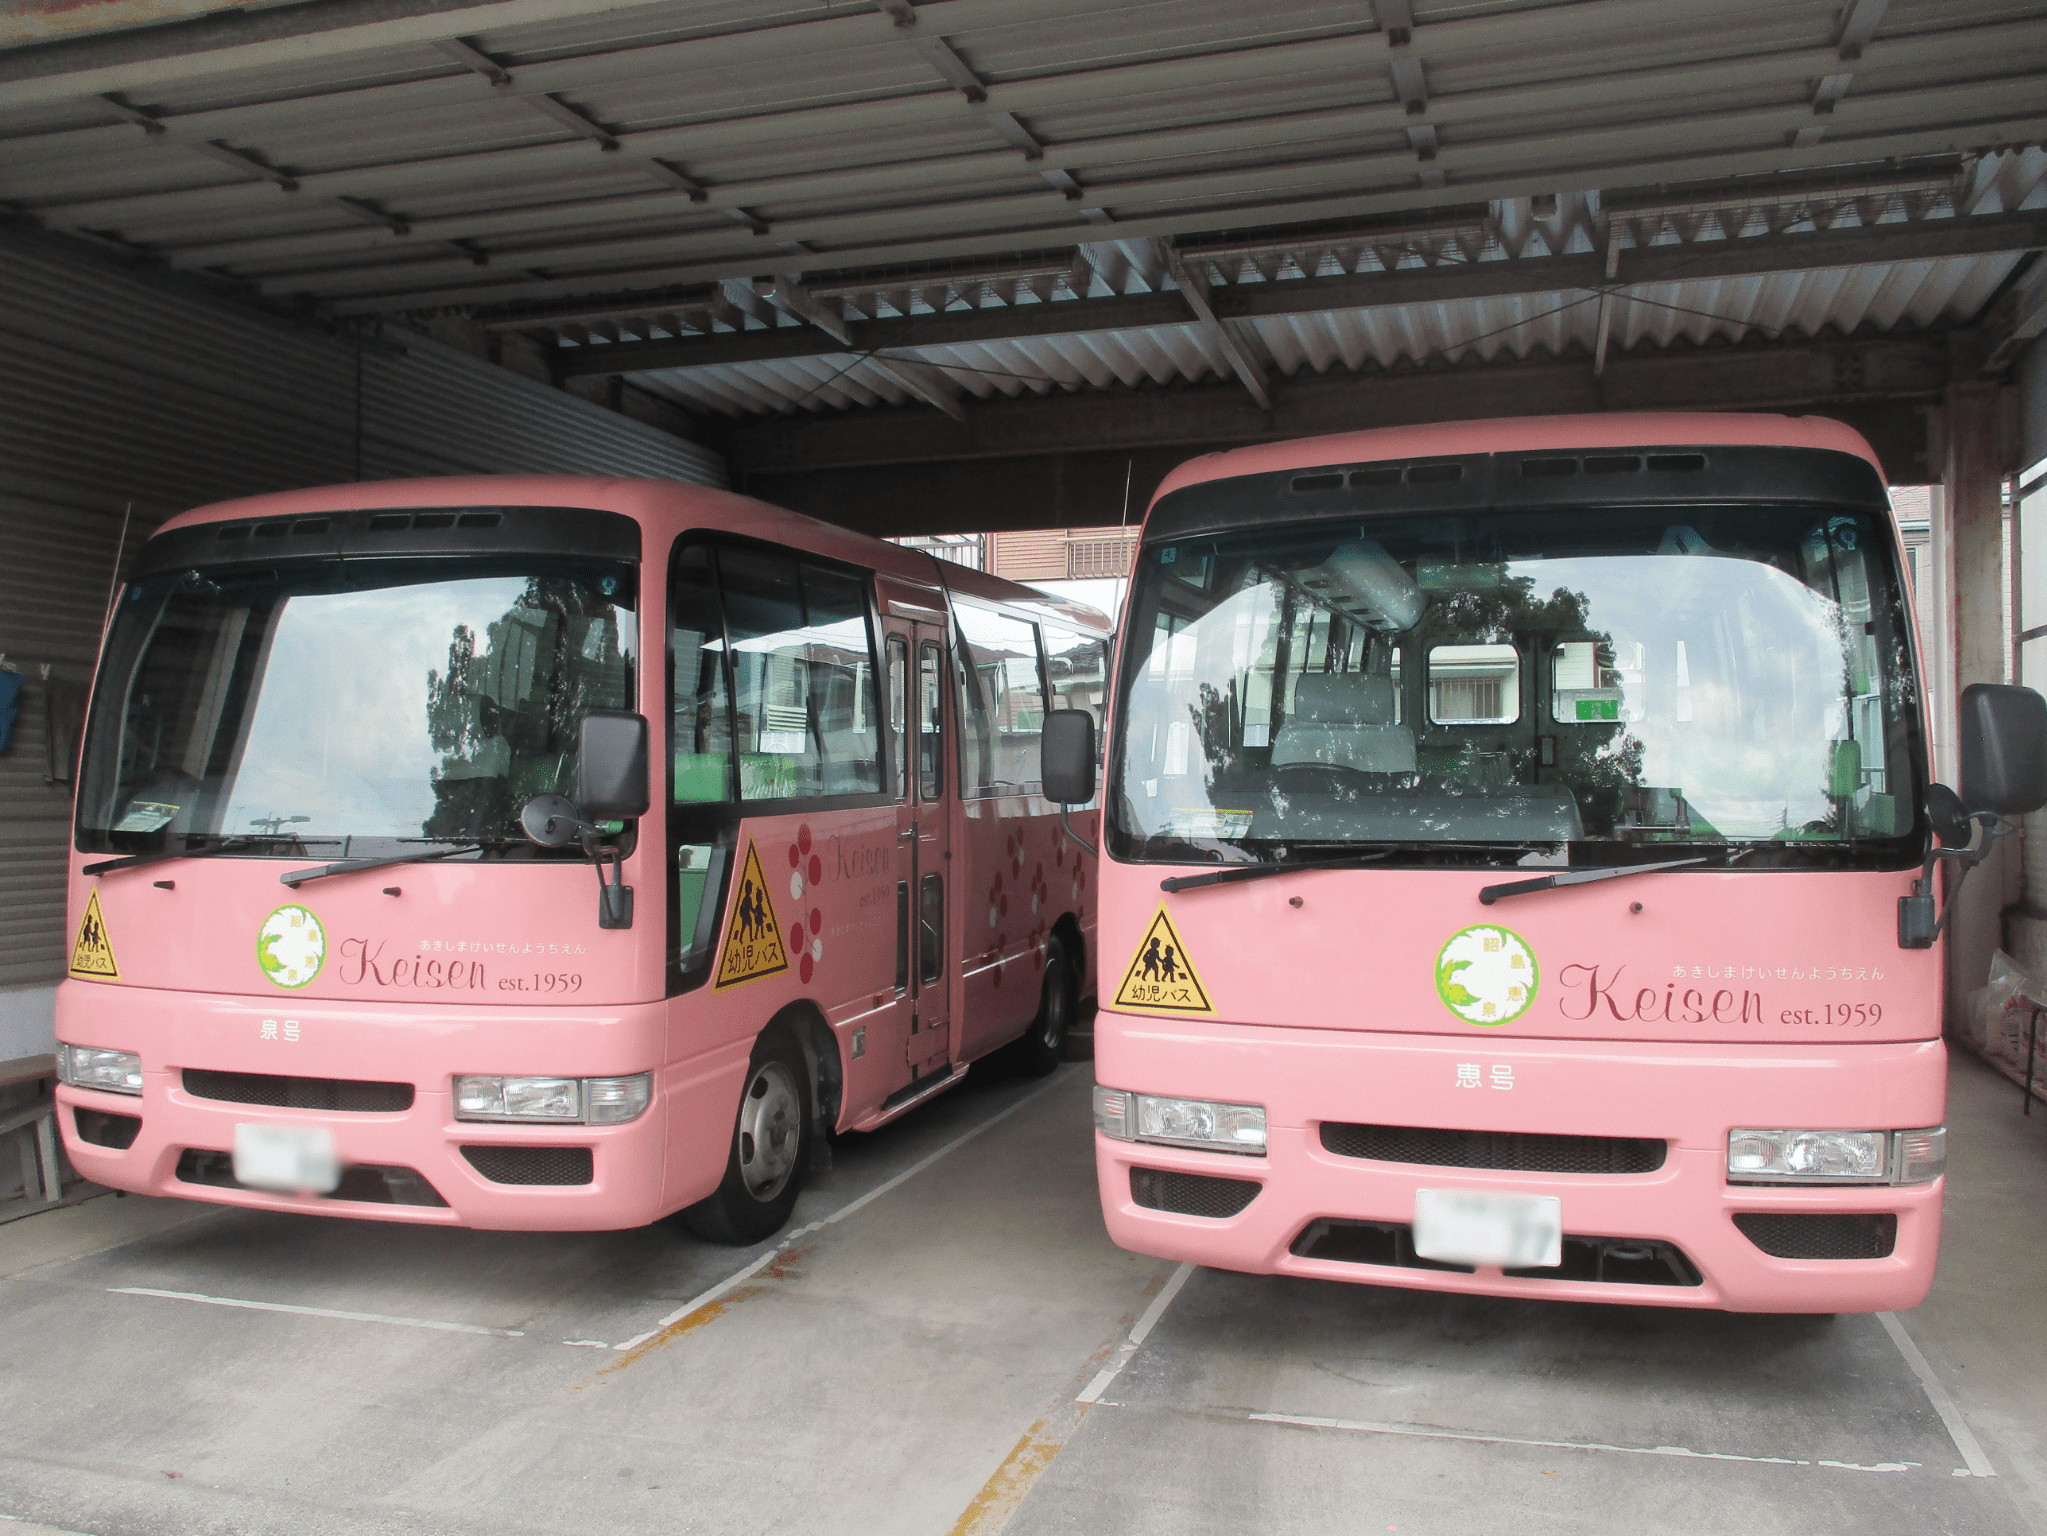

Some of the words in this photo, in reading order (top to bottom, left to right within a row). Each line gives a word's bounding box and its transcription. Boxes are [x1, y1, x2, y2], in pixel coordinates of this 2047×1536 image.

[827, 834, 890, 882] Keisen
[420, 939, 587, 955] あきしまけいせんようちえん
[728, 942, 779, 974] 幼児バス
[339, 937, 487, 990] Keisen
[498, 973, 583, 994] est.1959
[1672, 964, 1885, 981] あきしまけいせんようちえん
[1131, 984, 1192, 1003] 幼児バス
[1559, 963, 1765, 1025] Keisen
[1780, 1002, 1883, 1028] est.1959
[260, 1018, 301, 1042] 泉号
[1454, 1063, 1516, 1091] 恵号
